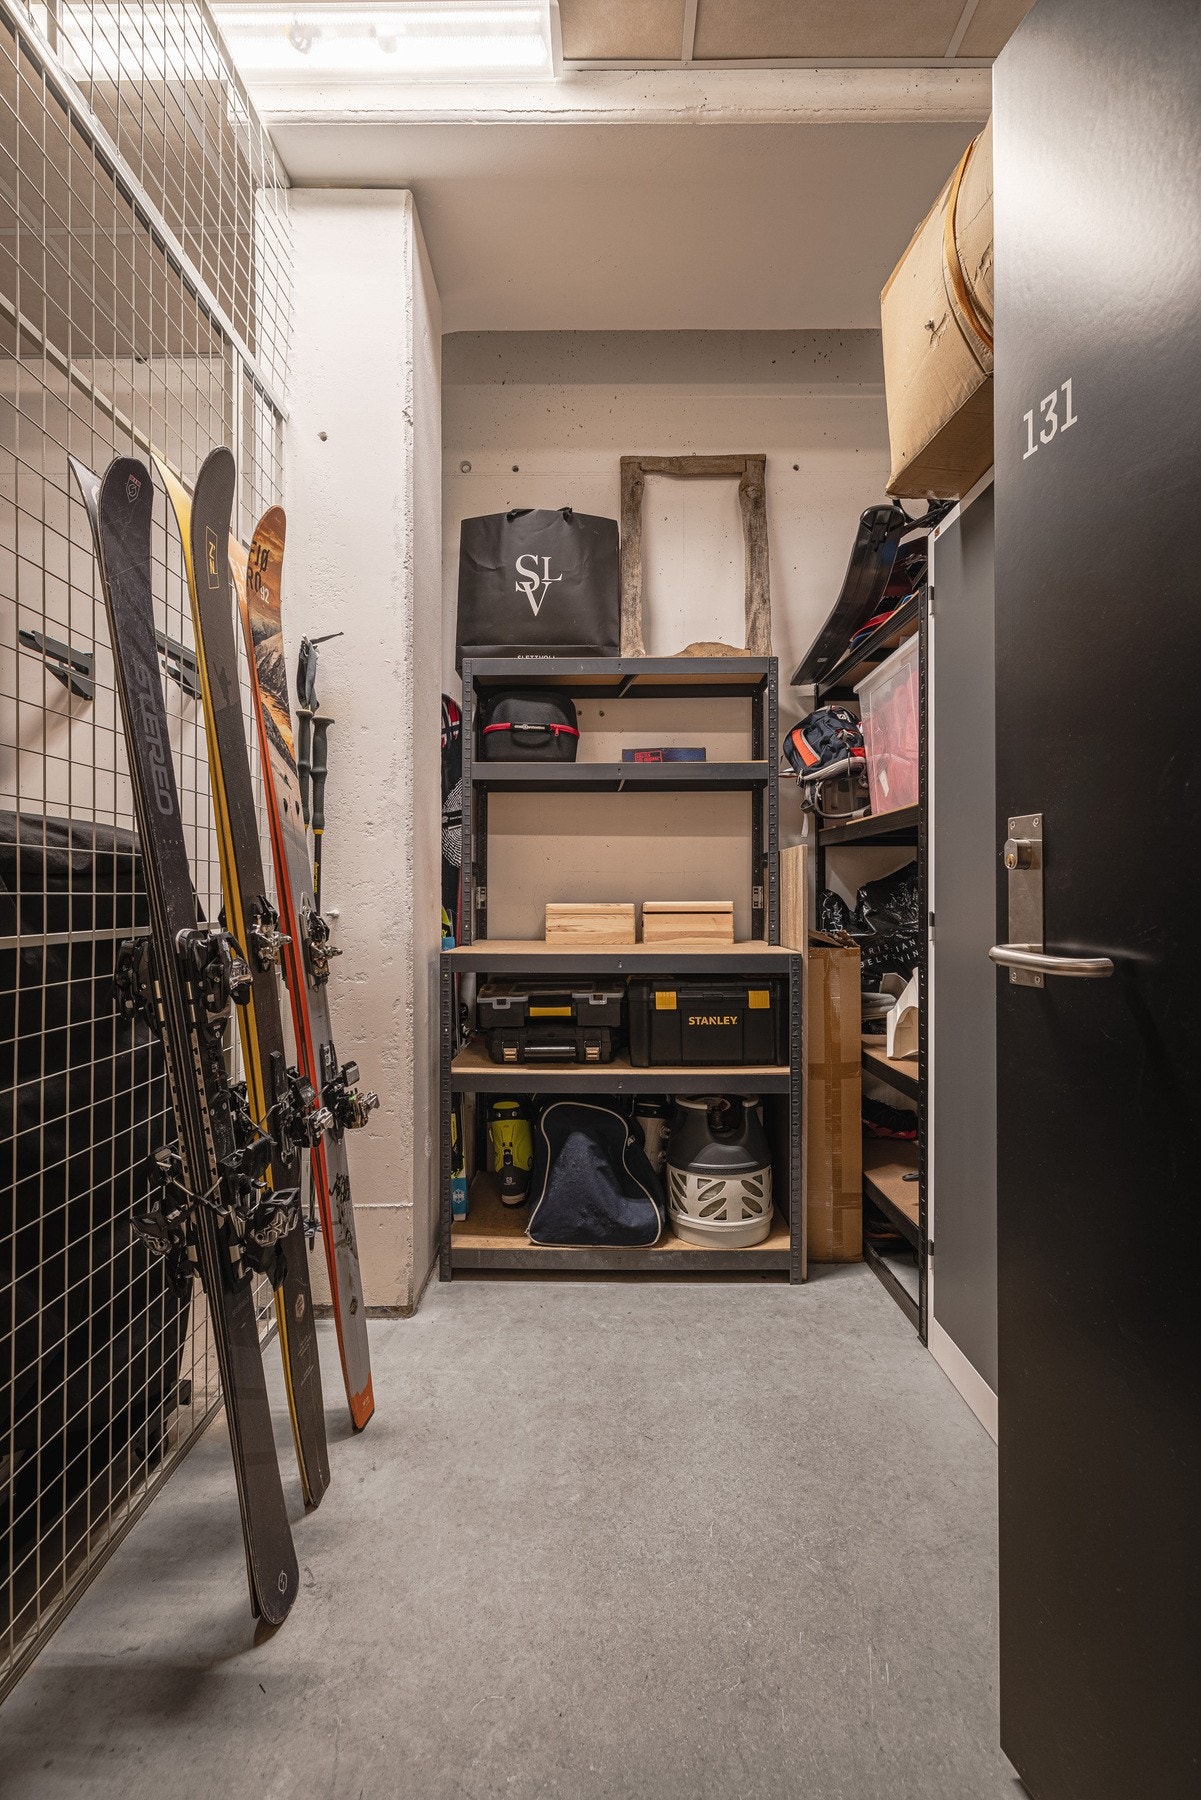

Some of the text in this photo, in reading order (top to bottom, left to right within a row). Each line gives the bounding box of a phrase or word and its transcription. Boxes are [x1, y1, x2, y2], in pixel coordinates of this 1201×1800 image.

[1023, 377, 1078, 460] 131
[260, 585, 270, 604] 92
[132, 658, 174, 815] STEREO
[688, 1016, 738, 1025] STANLEY
